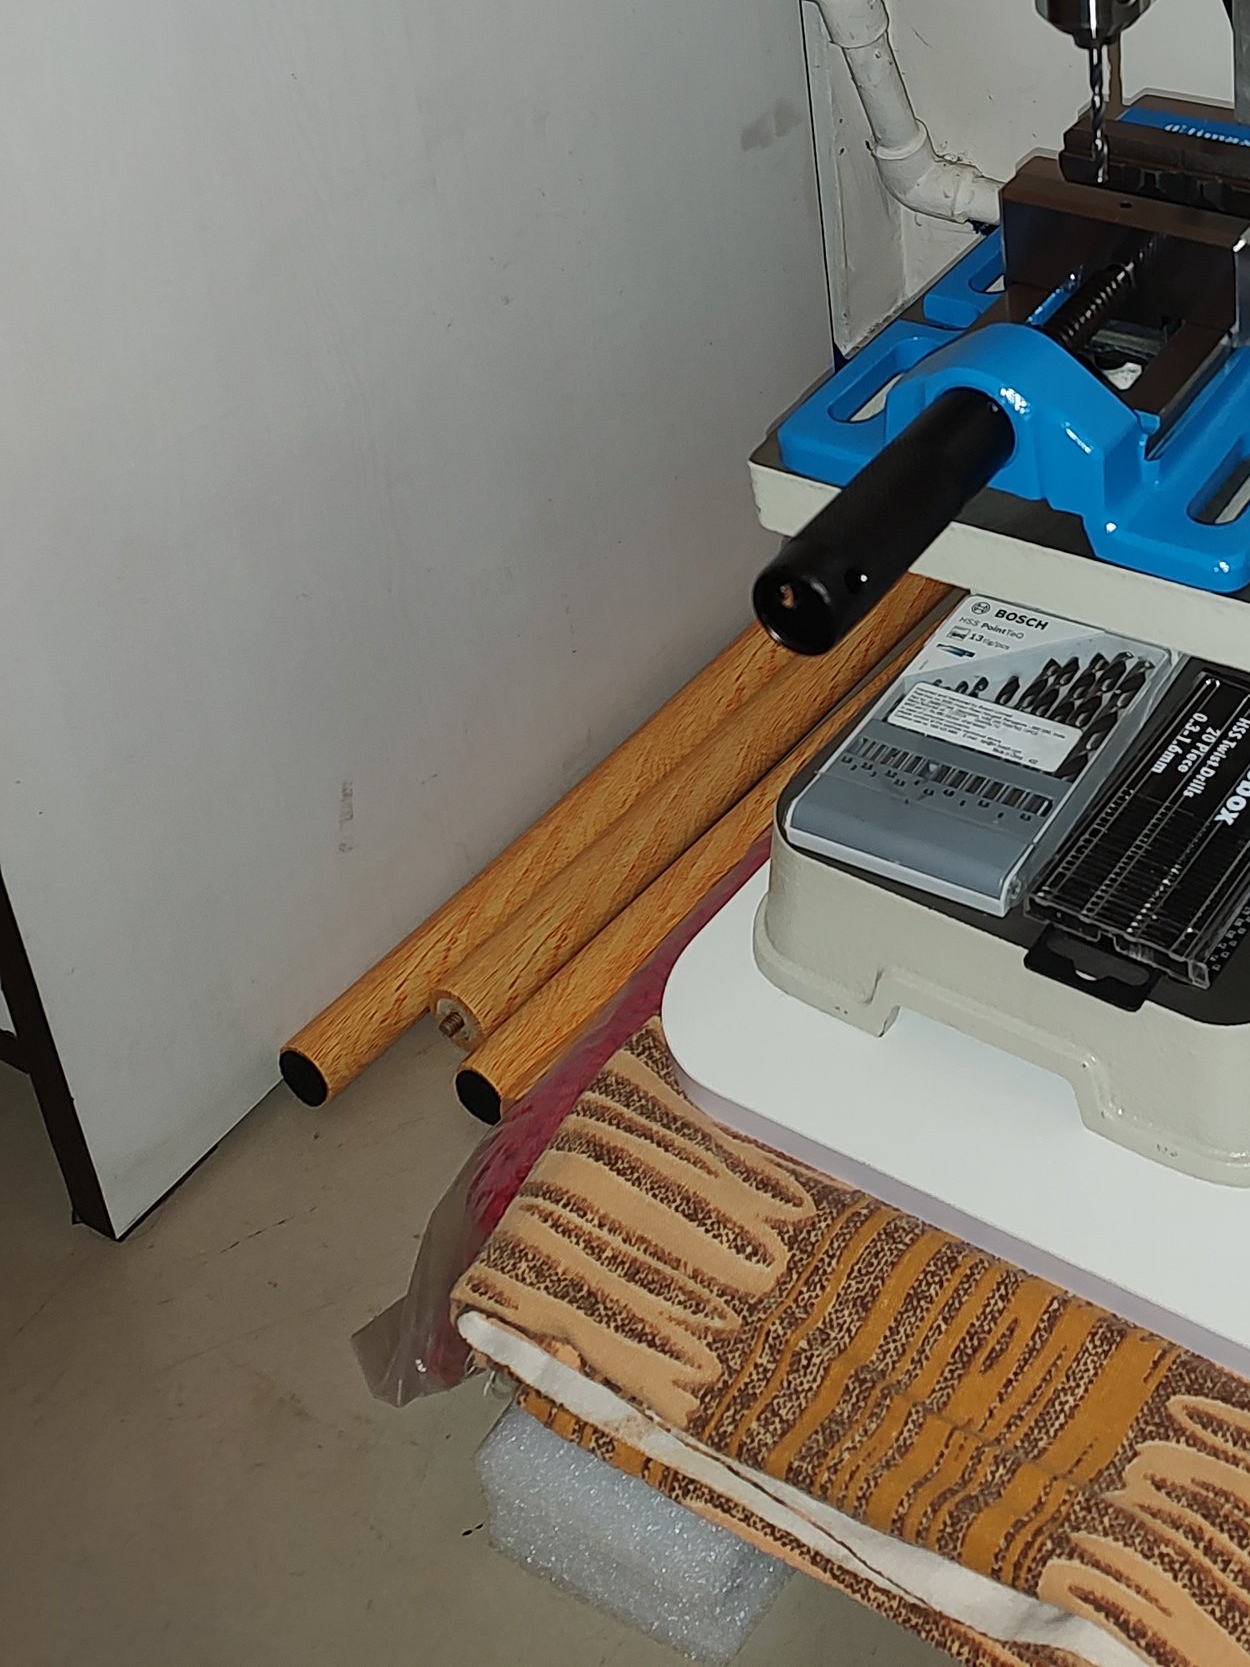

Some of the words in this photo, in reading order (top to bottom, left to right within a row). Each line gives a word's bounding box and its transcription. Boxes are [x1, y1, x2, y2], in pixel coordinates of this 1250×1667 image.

[958, 616, 981, 627] HSS
[994, 609, 1049, 631] BOSCH
[1150, 711, 1209, 774] 0.3-1.6mm
[1204, 725, 1221, 744] 20
[1176, 740, 1210, 773] Piece
[1213, 738, 1238, 767] Twist
[1182, 765, 1216, 798] Drills
